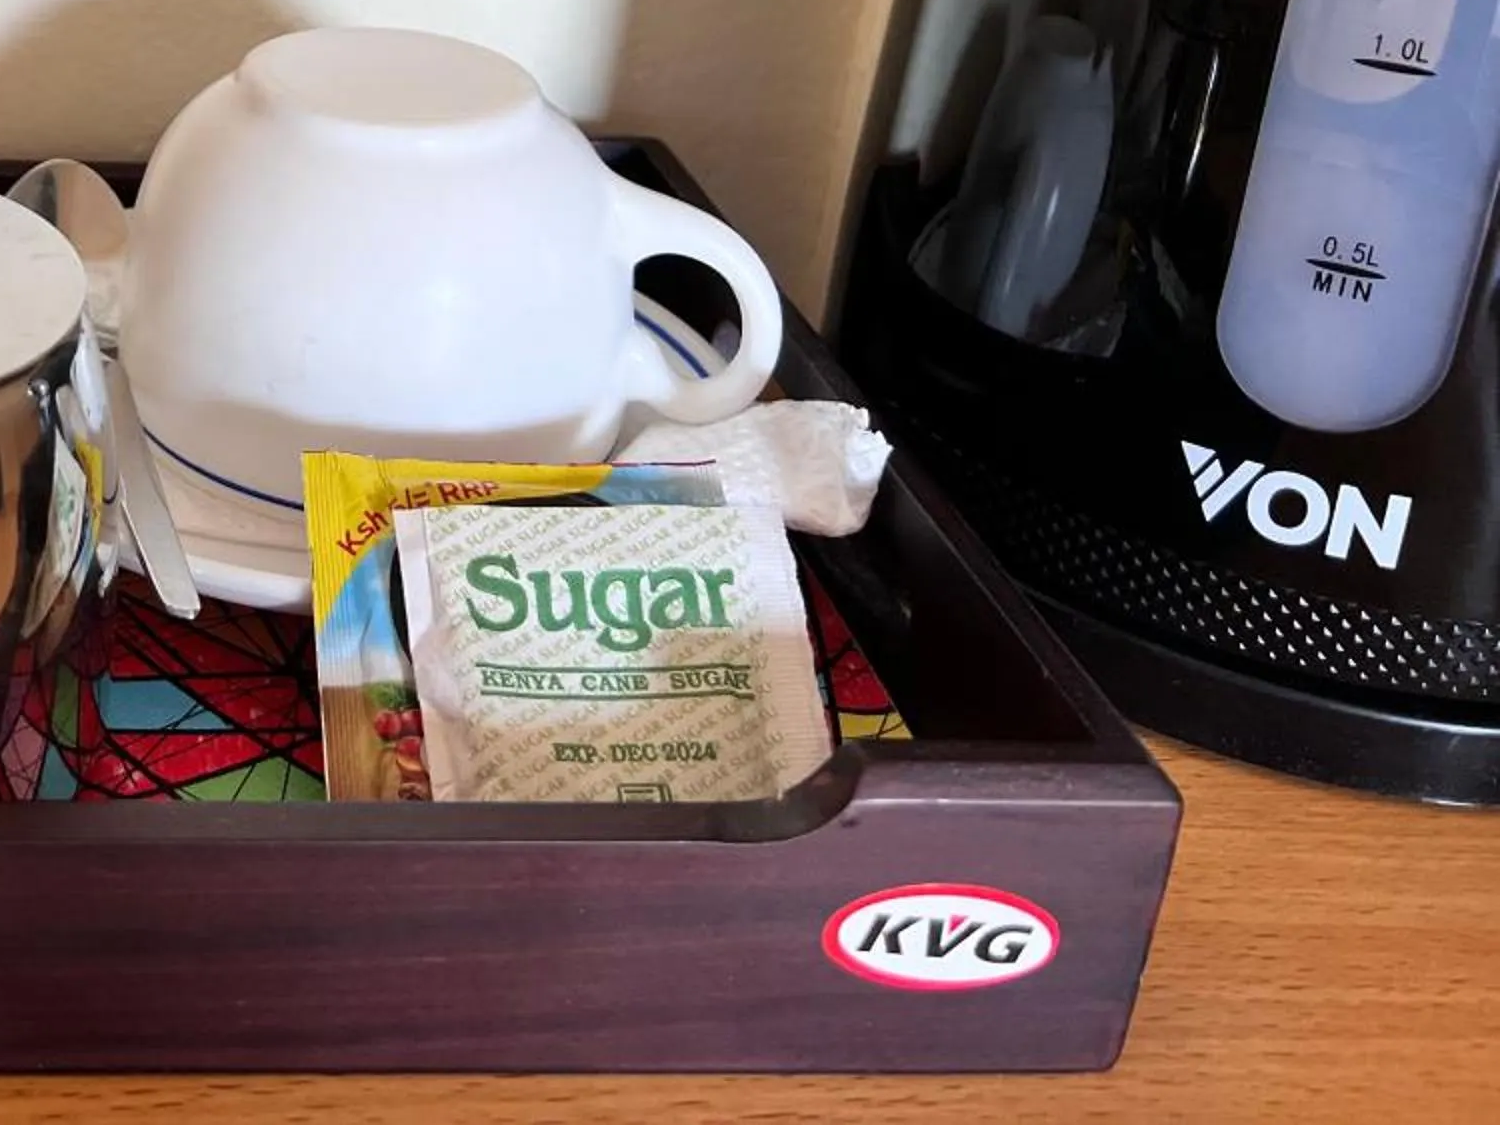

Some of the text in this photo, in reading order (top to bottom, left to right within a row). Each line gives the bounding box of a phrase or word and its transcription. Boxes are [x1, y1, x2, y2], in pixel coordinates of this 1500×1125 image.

[1373, 33, 1430, 64] 1.0L
[1323, 236, 1380, 268] 0.5L
[1312, 271, 1373, 303] MIN
[1181, 440, 1412, 570] VON
[337, 510, 390, 556] Ksh
[465, 554, 735, 651] Sugar
[481, 669, 752, 691] KENYA CANE SUGAR
[609, 743, 657, 762] DEC
[661, 741, 717, 762] 2024
[857, 914, 1034, 964] KVG
